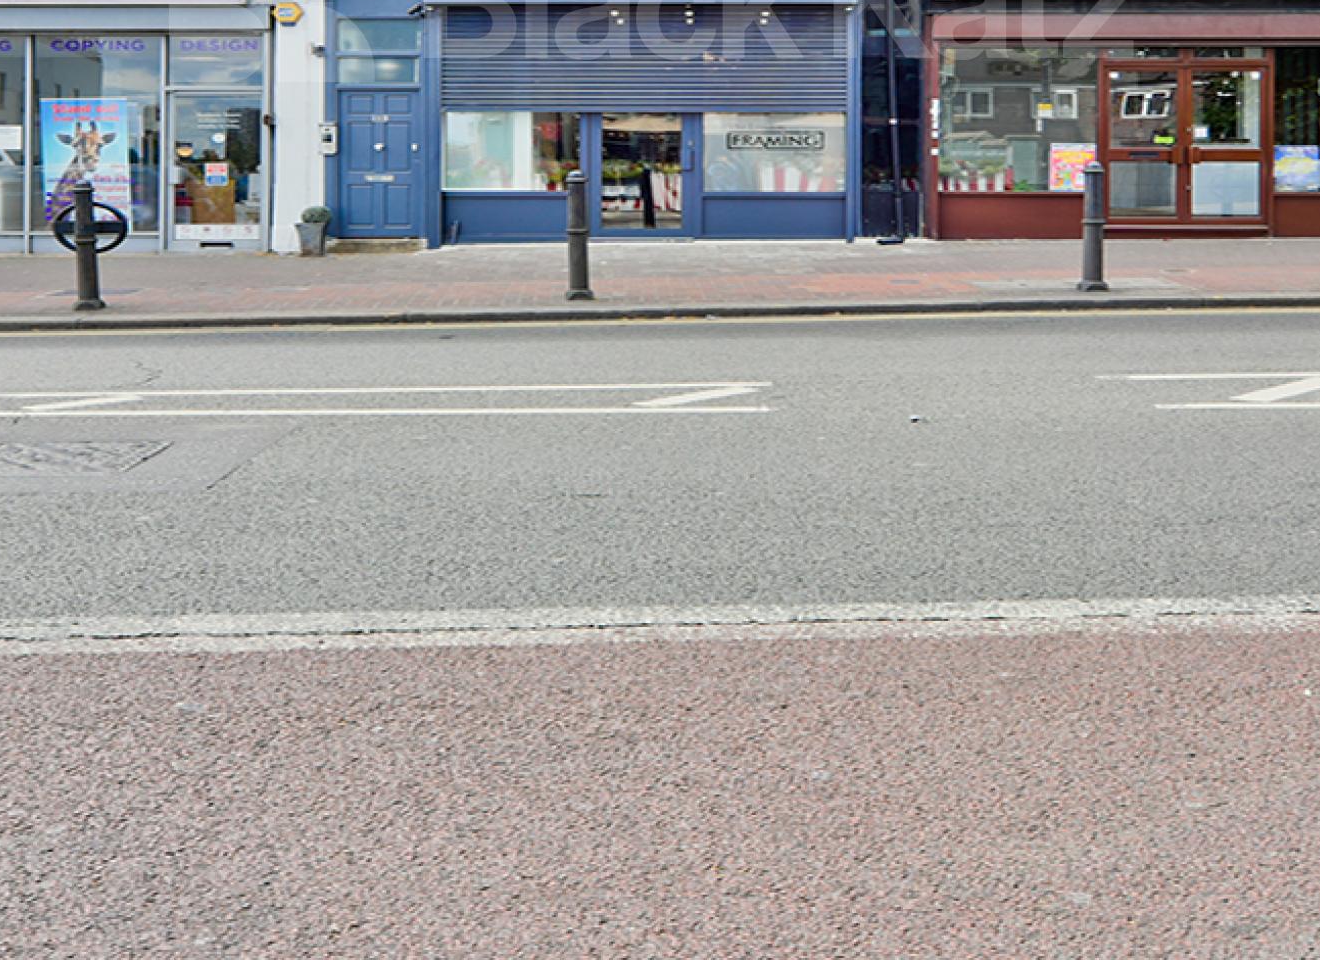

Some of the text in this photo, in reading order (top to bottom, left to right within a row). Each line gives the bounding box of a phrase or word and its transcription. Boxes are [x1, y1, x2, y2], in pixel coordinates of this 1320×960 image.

[50, 40, 146, 52] COPYING
[180, 40, 259, 52] DESIGN
[732, 134, 820, 149] FRAMING
